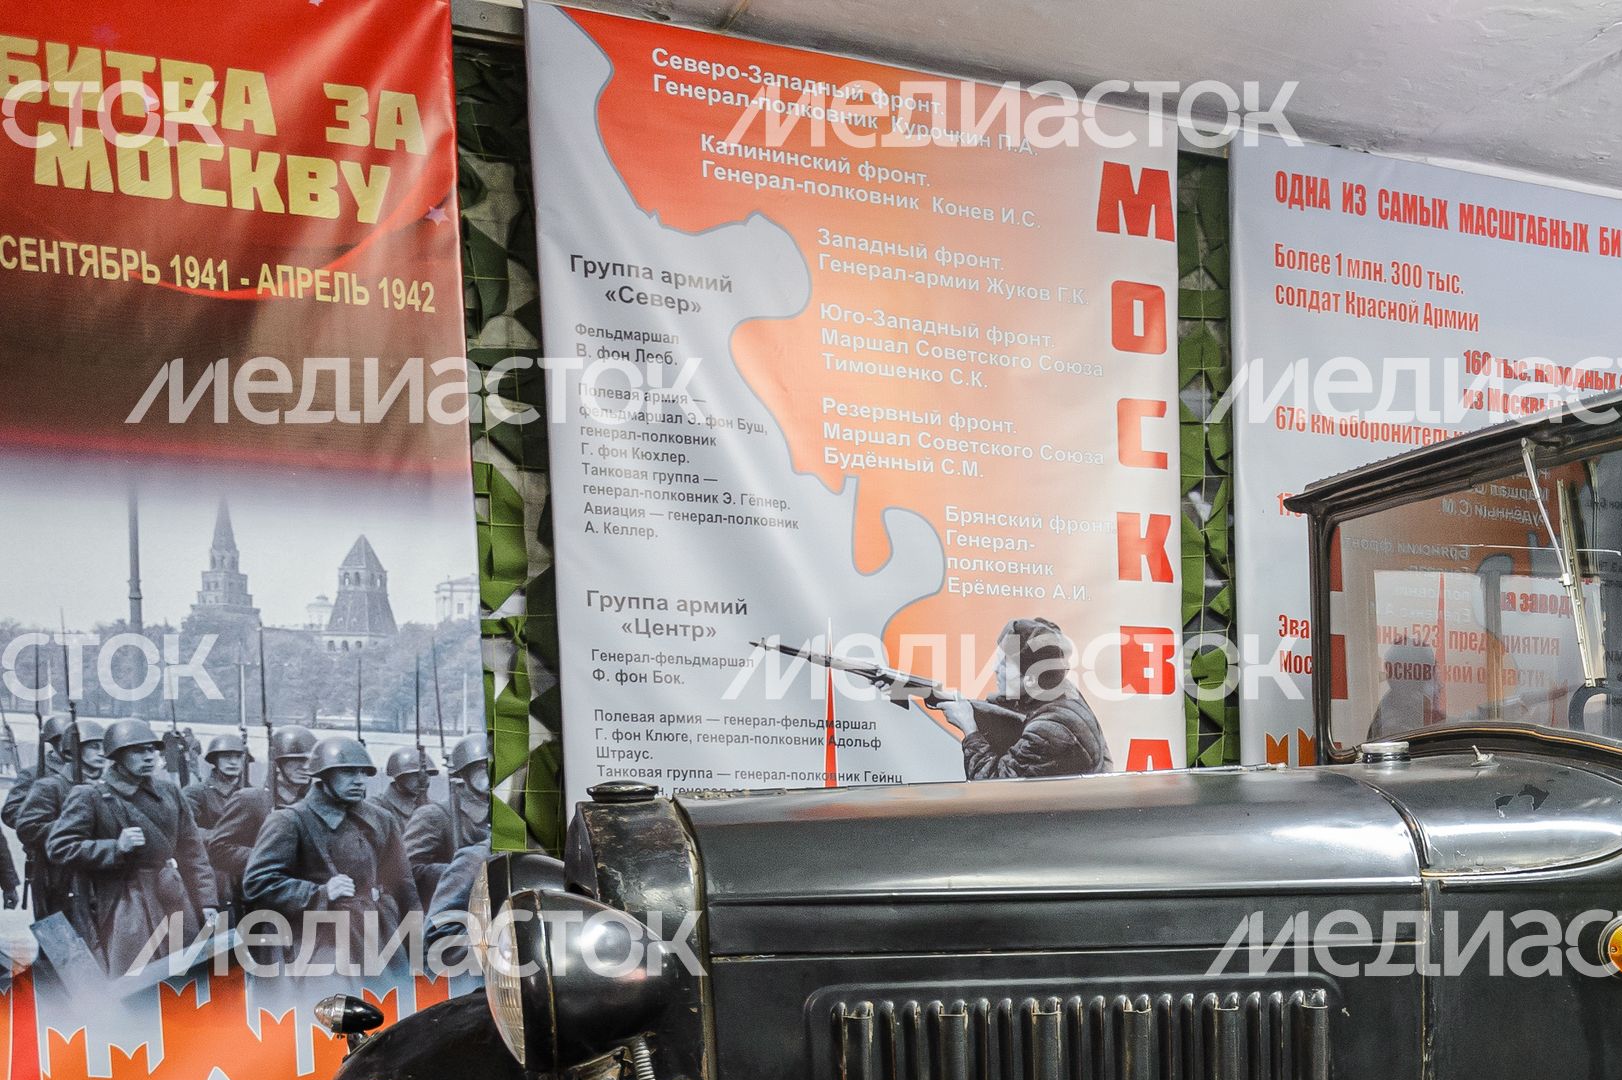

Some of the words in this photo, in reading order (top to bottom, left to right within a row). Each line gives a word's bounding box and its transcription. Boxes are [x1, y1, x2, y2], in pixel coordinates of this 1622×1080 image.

[0, 35, 277, 136] БИТВА
[323, 83, 427, 155] ЗА
[652, 48, 864, 101] Северо-Западный
[871, 87, 945, 115] фронт.
[653, 74, 878, 129] Генерал-полковник
[892, 116, 991, 148] Курочкин
[998, 134, 1038, 156] П.А.
[34, 121, 391, 224] МОСКВУ
[701, 134, 850, 174] Калининский
[858, 161, 931, 188] фронт.
[702, 160, 919, 210] Генерал-полковник
[932, 197, 994, 221] Конев
[1002, 209, 1041, 228] И.С.
[1275, 171, 1331, 211] ОДНА
[1342, 181, 1366, 216] ИЗ
[1378, 189, 1448, 230] САМЫХ
[1460, 203, 1589, 253] МАСШТАБНЫХ
[817, 229, 928, 260] Западный
[935, 247, 1004, 271] фронт.
[0, 235, 161, 284] СЕНТЯБРЬ
[170, 255, 230, 291] 1941
[257, 264, 369, 306] АПРЕЛЬ
[378, 278, 436, 313] 1942
[570, 254, 653, 280] Группа
[661, 270, 732, 293] армий
[819, 254, 980, 292] Генерал-армии
[987, 277, 1050, 301] Жуков
[1057, 287, 1089, 305] Г.К.
[1275, 243, 1330, 274] Более
[1336, 253, 1342, 276] 1
[1348, 259, 1386, 283] млн.
[1391, 261, 1422, 289] 300
[1427, 271, 1464, 294] тыс.
[605, 286, 701, 314] «Север»
[1275, 284, 1340, 313] солдат
[1346, 290, 1418, 324] Красной
[1423, 303, 1479, 332] Армии
[575, 323, 679, 345] Фельдмаршал
[821, 303, 979, 340] Юго-Западный
[986, 325, 1055, 348] фронт.
[576, 343, 592, 358] В.
[597, 346, 630, 362] фон
[822, 328, 908, 354] Маршал
[916, 339, 1031, 369] Советского
[1039, 355, 1104, 376] Союза
[822, 352, 943, 383] Тимошенко
[950, 368, 988, 388] С.К.
[1464, 350, 1491, 376] 160
[1535, 363, 1616, 391] народных
[578, 383, 639, 401] Полевая
[644, 391, 688, 407] армия
[1463, 389, 1484, 410] из
[706, 415, 733, 430] фон
[822, 397, 941, 426] Резервный
[949, 412, 1017, 434] фронт.
[1275, 406, 1306, 431] 676
[1312, 414, 1334, 435] км
[580, 425, 716, 447] генерал-полковник
[823, 422, 911, 447] Маршал
[917, 432, 1033, 459] Советского
[1040, 444, 1104, 465] Союза
[598, 445, 627, 459] фон
[633, 448, 690, 465] Кюхлер.
[824, 447, 934, 473] Будённый
[941, 459, 984, 478] С.М.
[582, 462, 648, 481] Танковая
[653, 471, 699, 485] группа
[583, 484, 718, 505] генерал-полковник
[584, 502, 645, 519] Авиация
[668, 512, 799, 530] генерал-полковник
[945, 505, 1042, 528] Брянский
[604, 523, 658, 539] Келлер.
[946, 530, 1035, 552] Генерал-
[948, 556, 1054, 576] полковник
[587, 590, 668, 612] Группа
[676, 598, 748, 616] армий
[948, 577, 1045, 599] Ерёменко
[1052, 586, 1091, 601] А.И.
[621, 618, 716, 641] «Центр»
[592, 649, 754, 669] Генерал-фельдмаршал
[592, 668, 610, 682] Ф.
[615, 669, 647, 685] фон
[653, 671, 685, 685] Бок.
[594, 709, 655, 724] Полевая
[659, 713, 702, 726] армия
[723, 714, 877, 732] генерал-фельдмаршал
[612, 728, 641, 743] фон
[696, 732, 824, 748] генерал-полковник
[827, 736, 882, 751] Адольф
[596, 746, 654, 762] Штраус.
[597, 765, 662, 780] Танковая
[667, 768, 713, 782] группа
[735, 769, 860, 784] генерал-полковник
[864, 770, 903, 785] Гейнц
